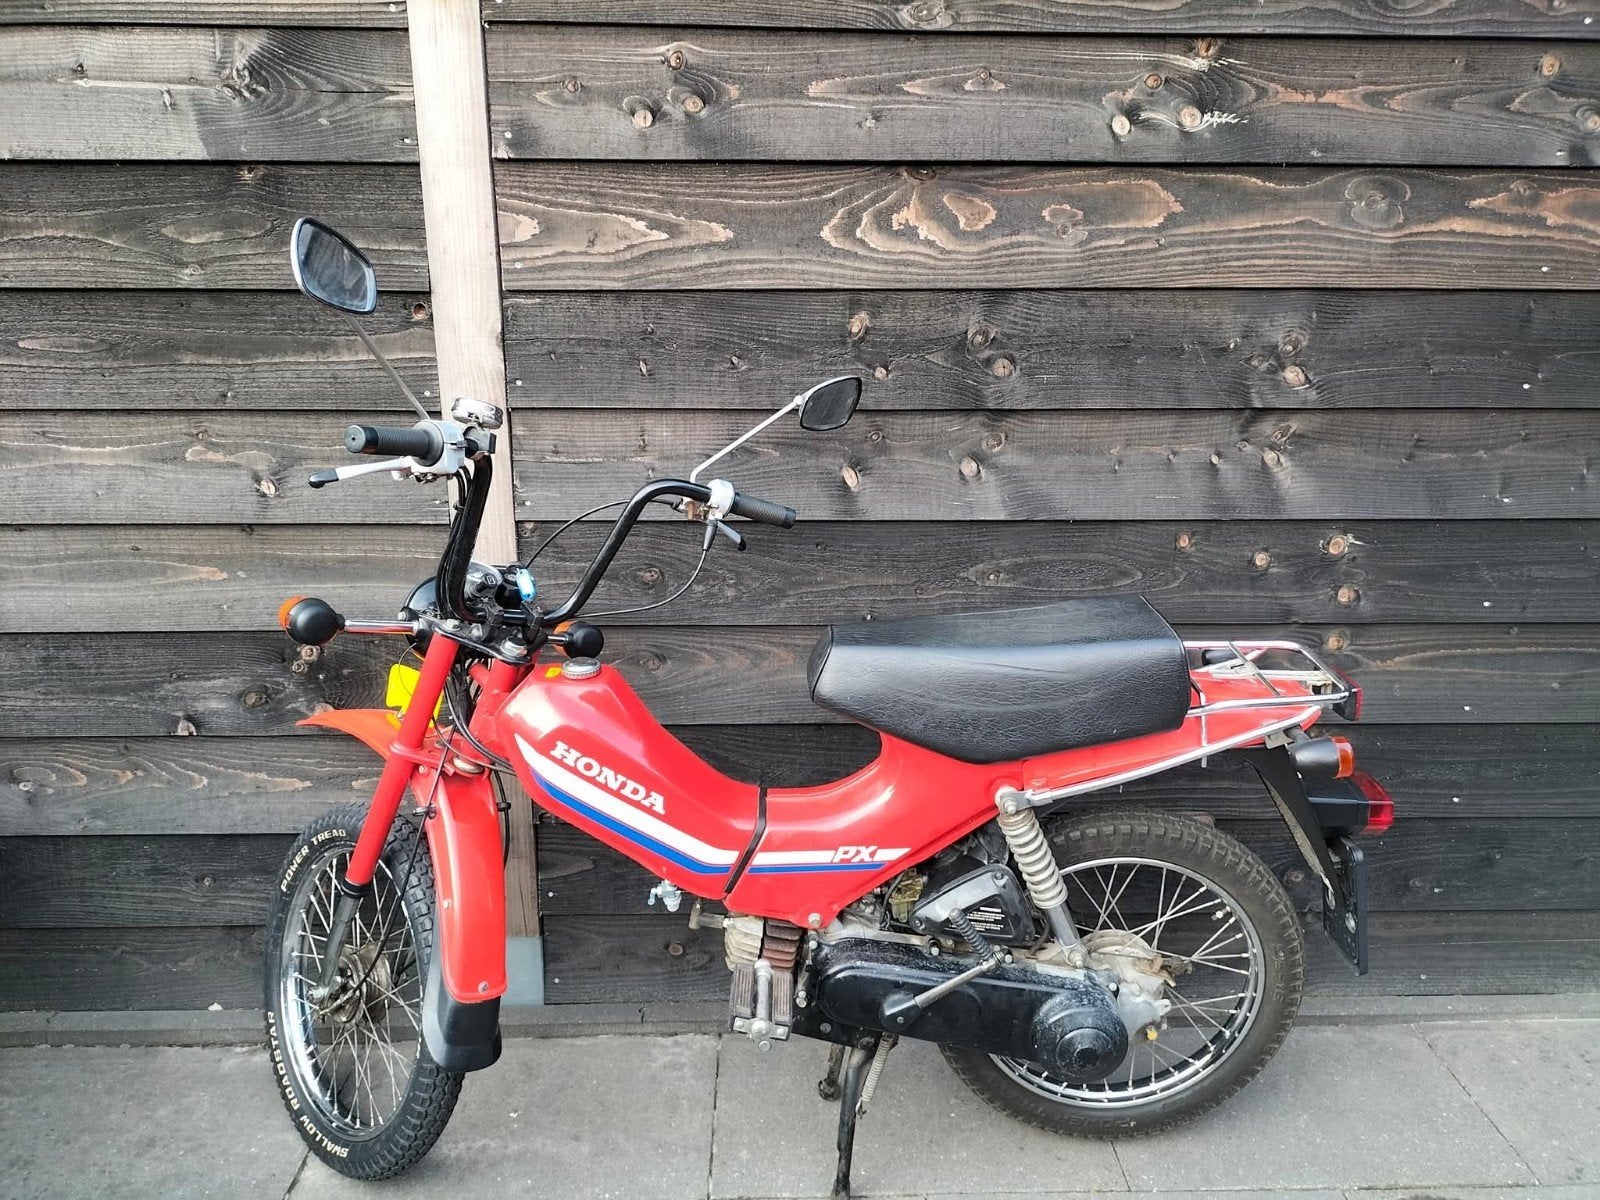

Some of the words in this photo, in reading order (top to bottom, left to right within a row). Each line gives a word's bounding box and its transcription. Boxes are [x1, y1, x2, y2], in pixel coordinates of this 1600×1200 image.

[549, 740, 666, 815] HONDA
[280, 845, 310, 893] POWER
[310, 829, 347, 846] TREAD
[831, 845, 878, 863] PX
[267, 1010, 300, 1111] ROADSTAR
[299, 1114, 349, 1158] SWALLOW
